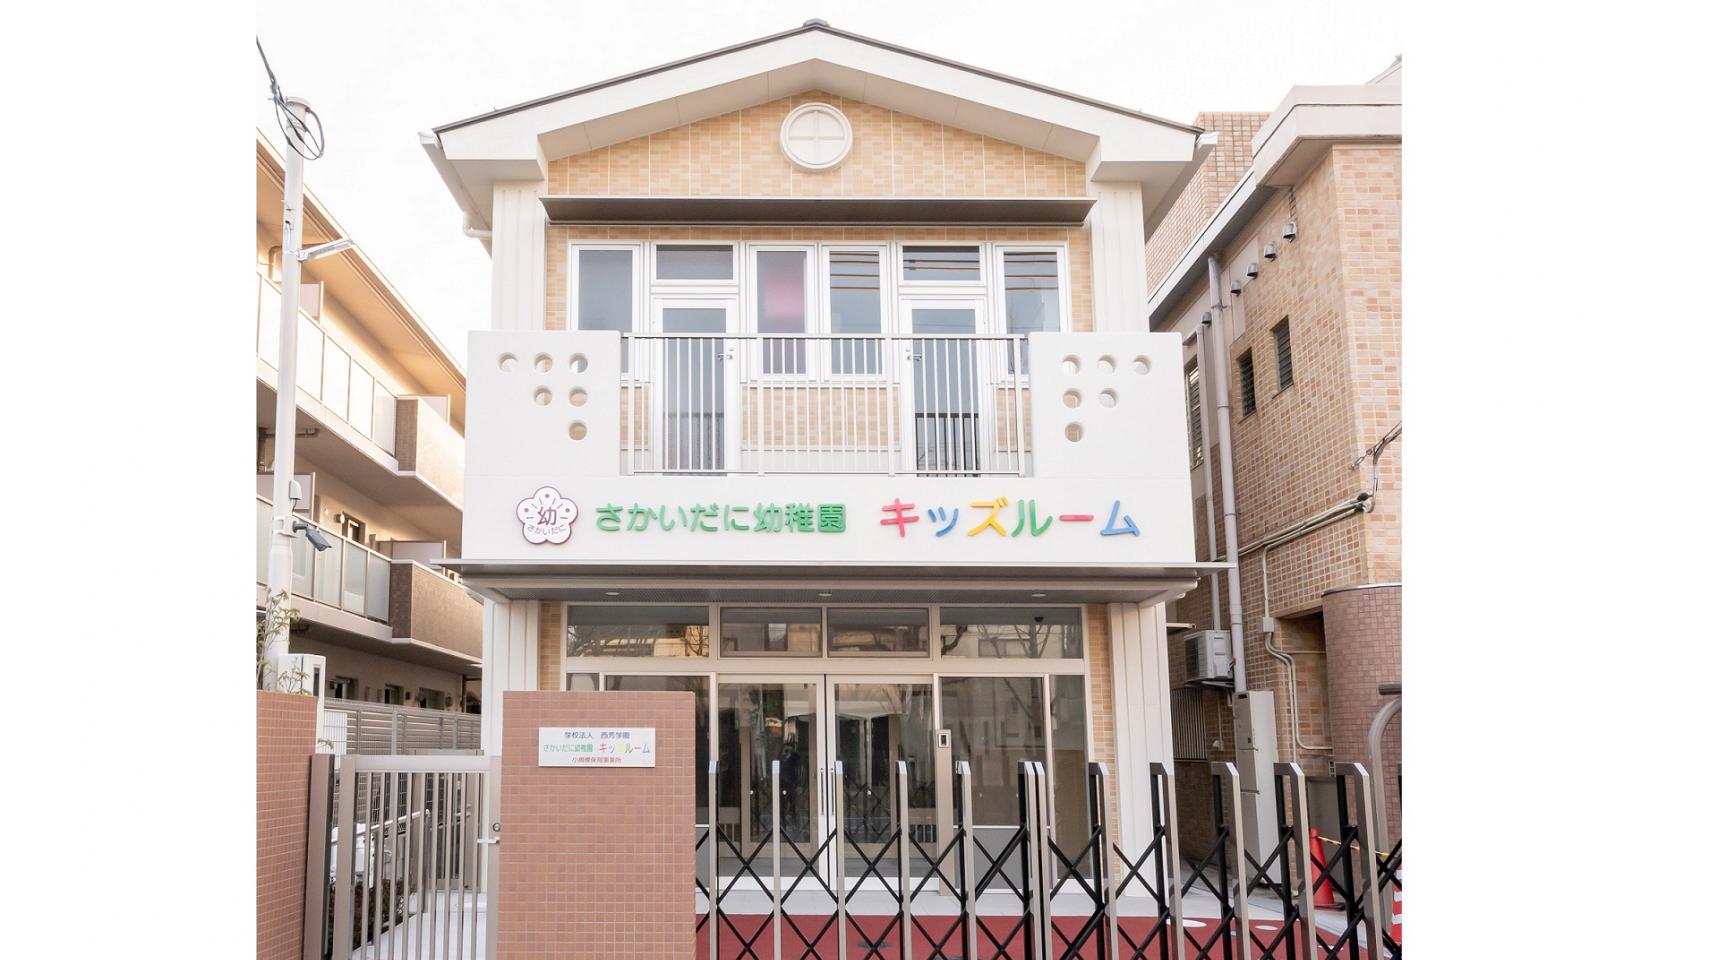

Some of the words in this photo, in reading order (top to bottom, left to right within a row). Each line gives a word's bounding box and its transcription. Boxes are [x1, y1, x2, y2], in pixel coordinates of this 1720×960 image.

[537, 506, 557, 526] 幼
[594, 502, 847, 533] さかいだに幼稚園
[880, 496, 1141, 538] キッズルーム
[599, 741, 650, 754] キッルーム
